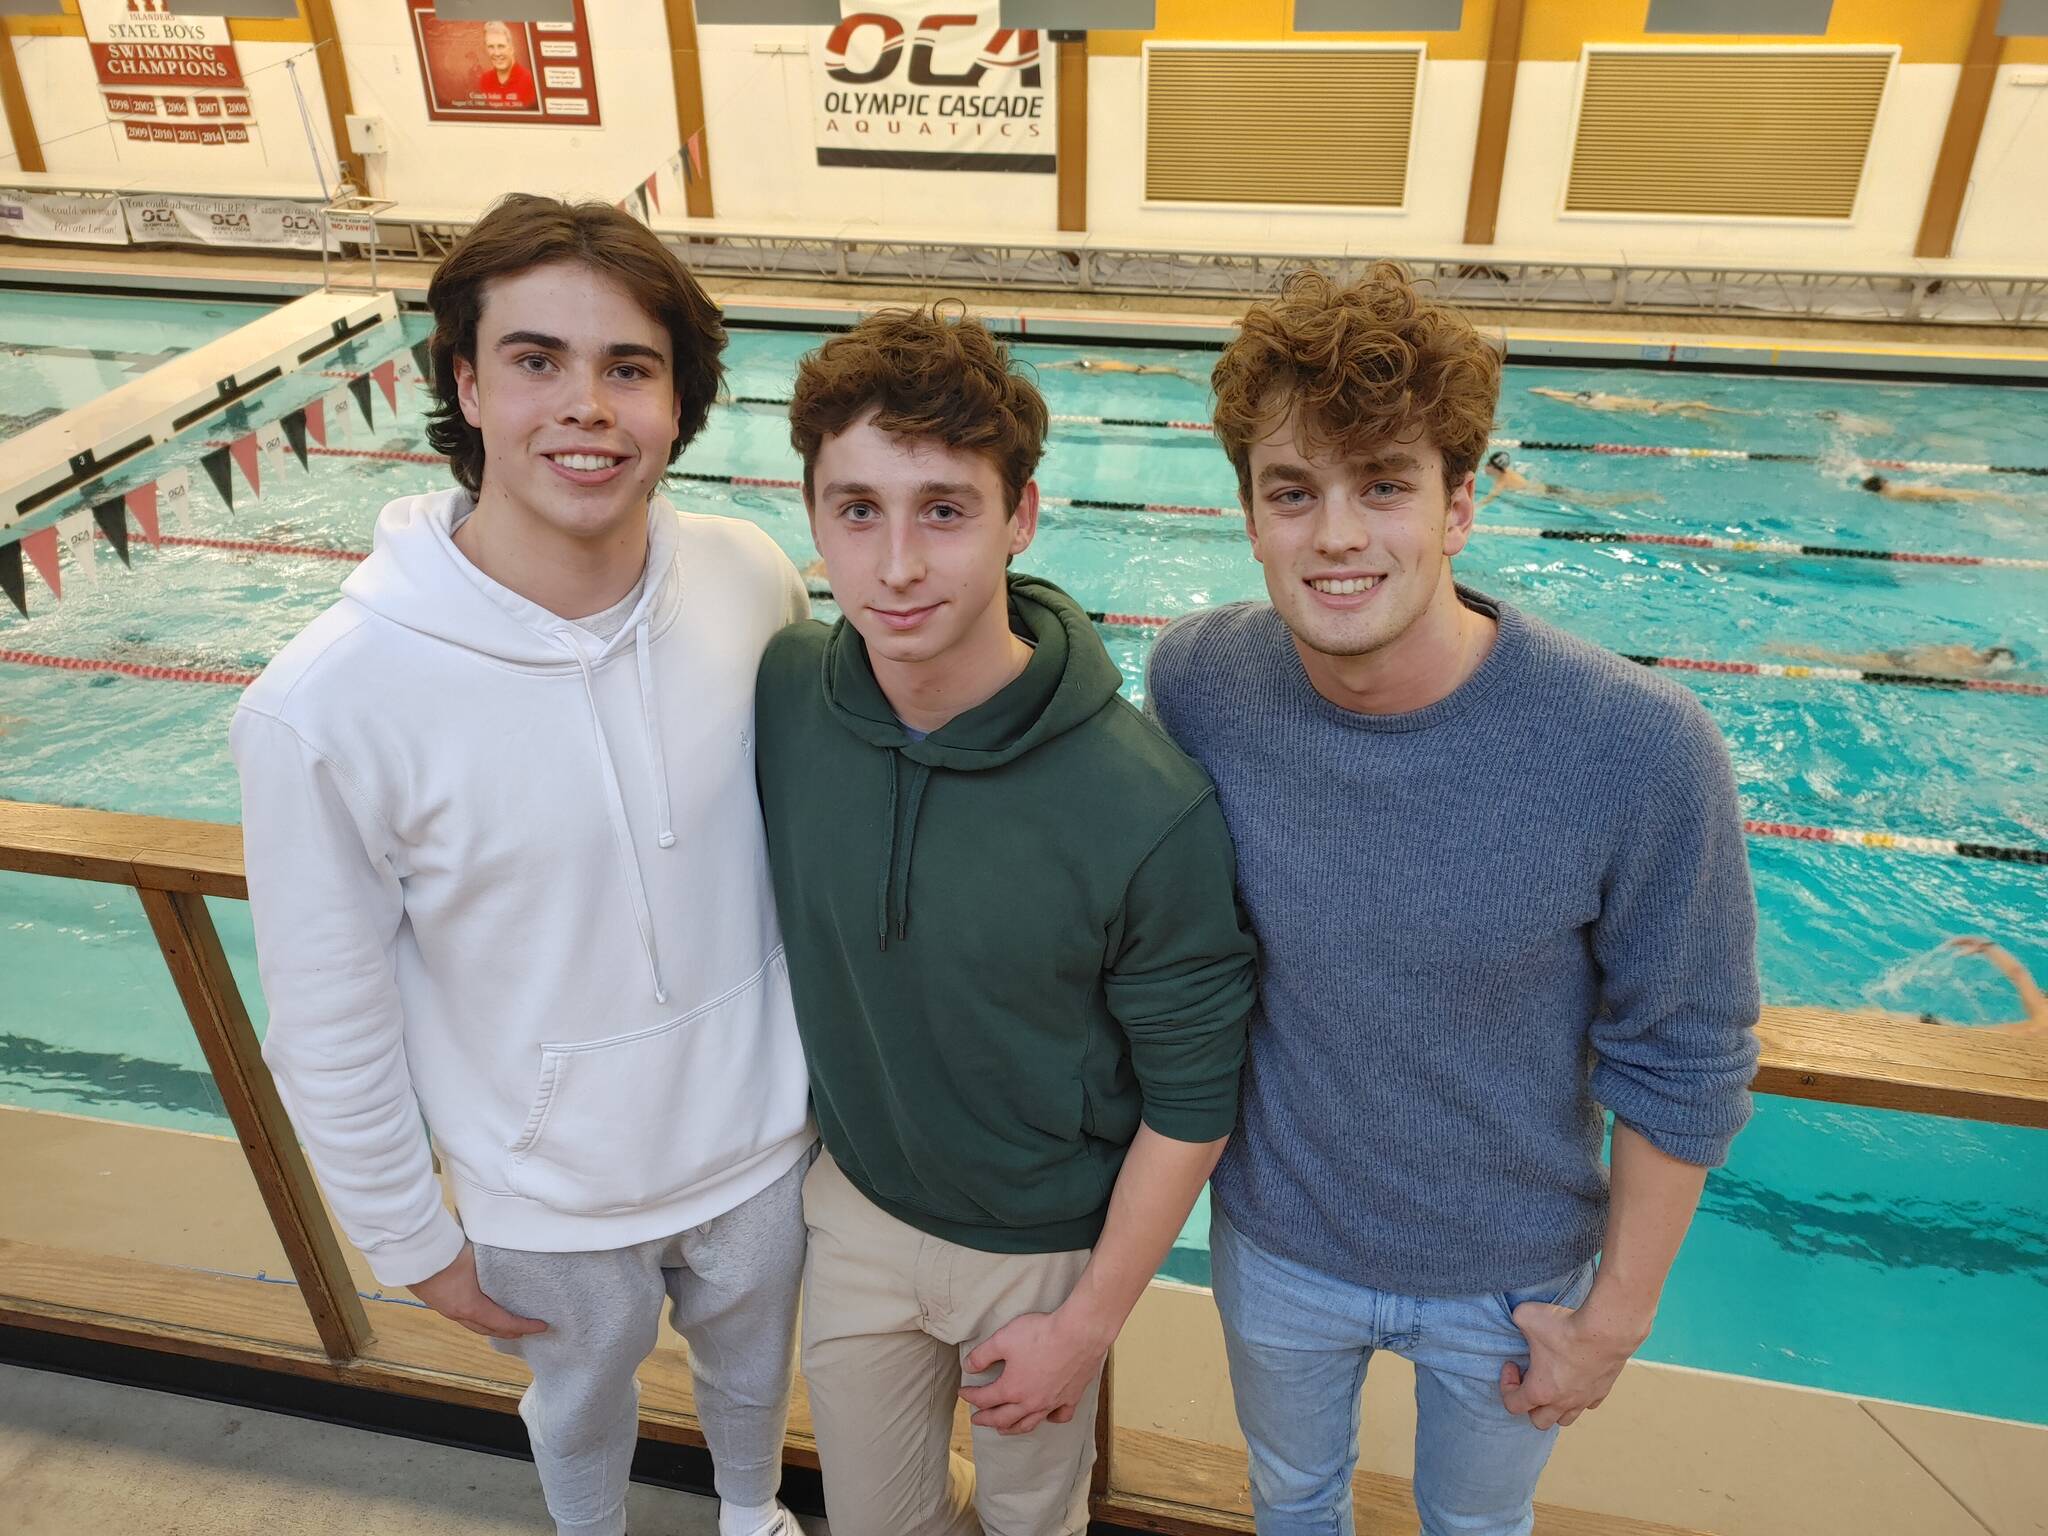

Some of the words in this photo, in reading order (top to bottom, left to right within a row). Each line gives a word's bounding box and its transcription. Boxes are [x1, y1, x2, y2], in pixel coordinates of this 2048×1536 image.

[108, 24, 159, 38] STATE
[163, 25, 205, 39] BOYS
[108, 44, 216, 60] SWIMMING
[825, 13, 1041, 88] OCA
[107, 59, 228, 76] CHAMPIONS
[109, 99, 130, 110] 1998
[132, 101, 155, 112] 2002
[198, 103, 219, 113] 2007
[824, 92, 929, 116] OLYMPIC
[938, 96, 1044, 118] CASCADE
[127, 126, 148, 138] 2009
[153, 128, 174, 139] 2010
[178, 130, 197, 140] 2011
[826, 119, 1040, 137] AQUATICS
[142, 209, 178, 223] OCA
[211, 214, 250, 227] OCA
[281, 215, 319, 230] OCA
[78, 455, 85, 466] 3
